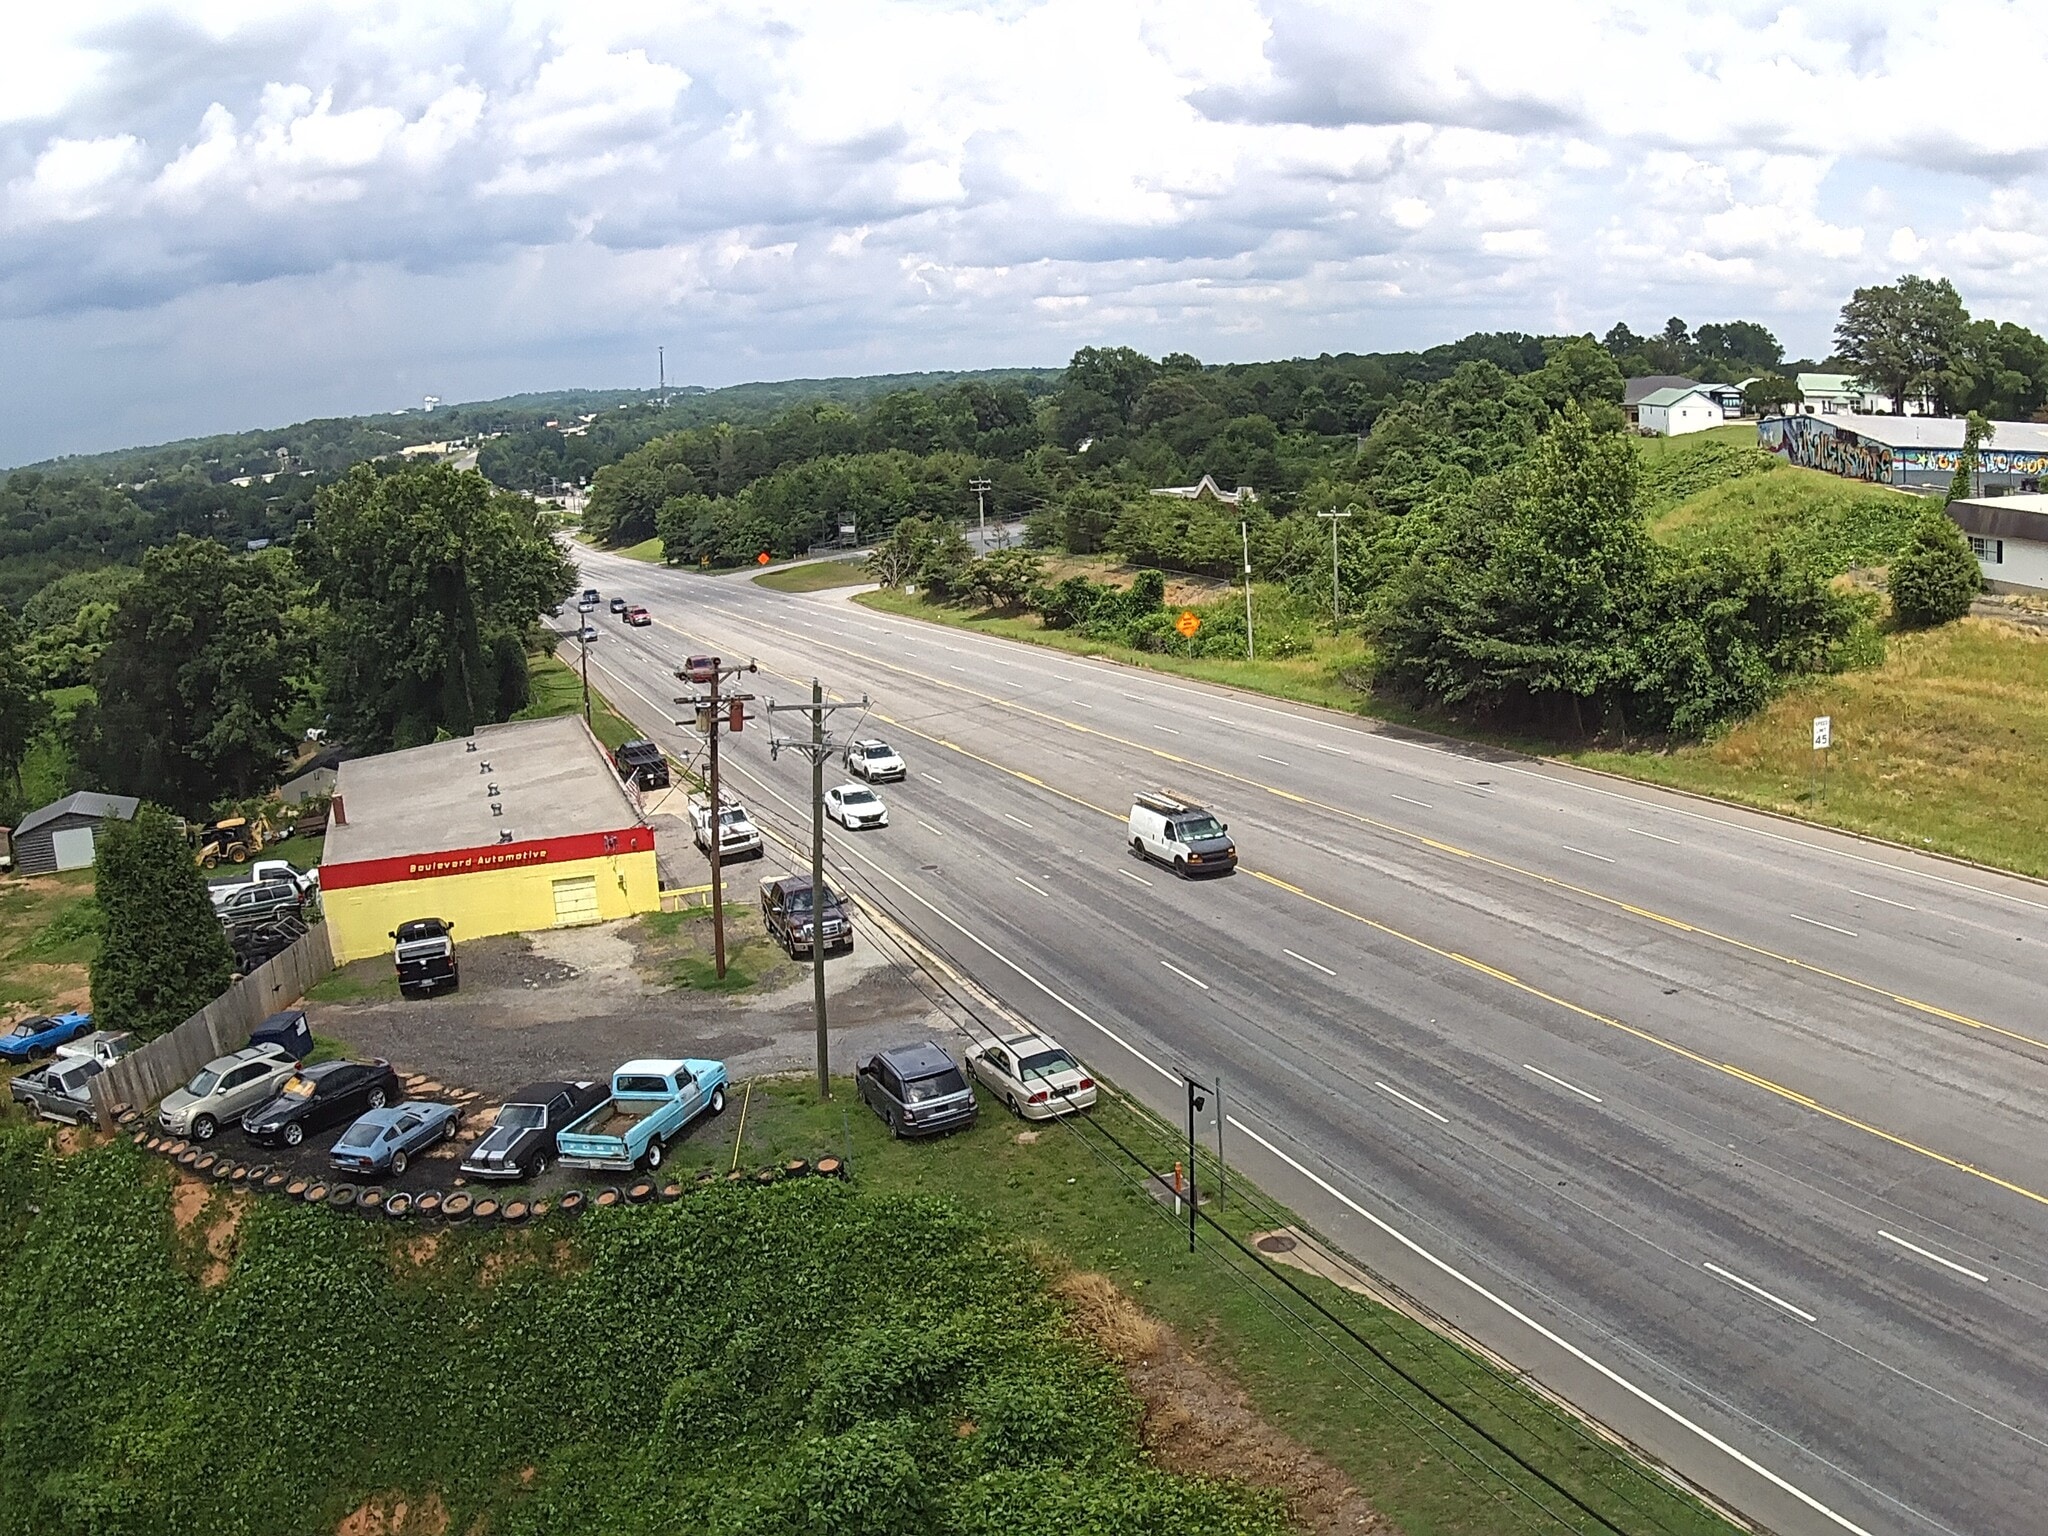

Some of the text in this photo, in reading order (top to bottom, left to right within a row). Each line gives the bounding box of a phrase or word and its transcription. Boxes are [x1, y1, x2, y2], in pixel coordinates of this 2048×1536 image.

[1815, 734, 1827, 744] 45
[409, 849, 548, 873] Boulevard Automotive
[568, 1143, 619, 1152] FORD
